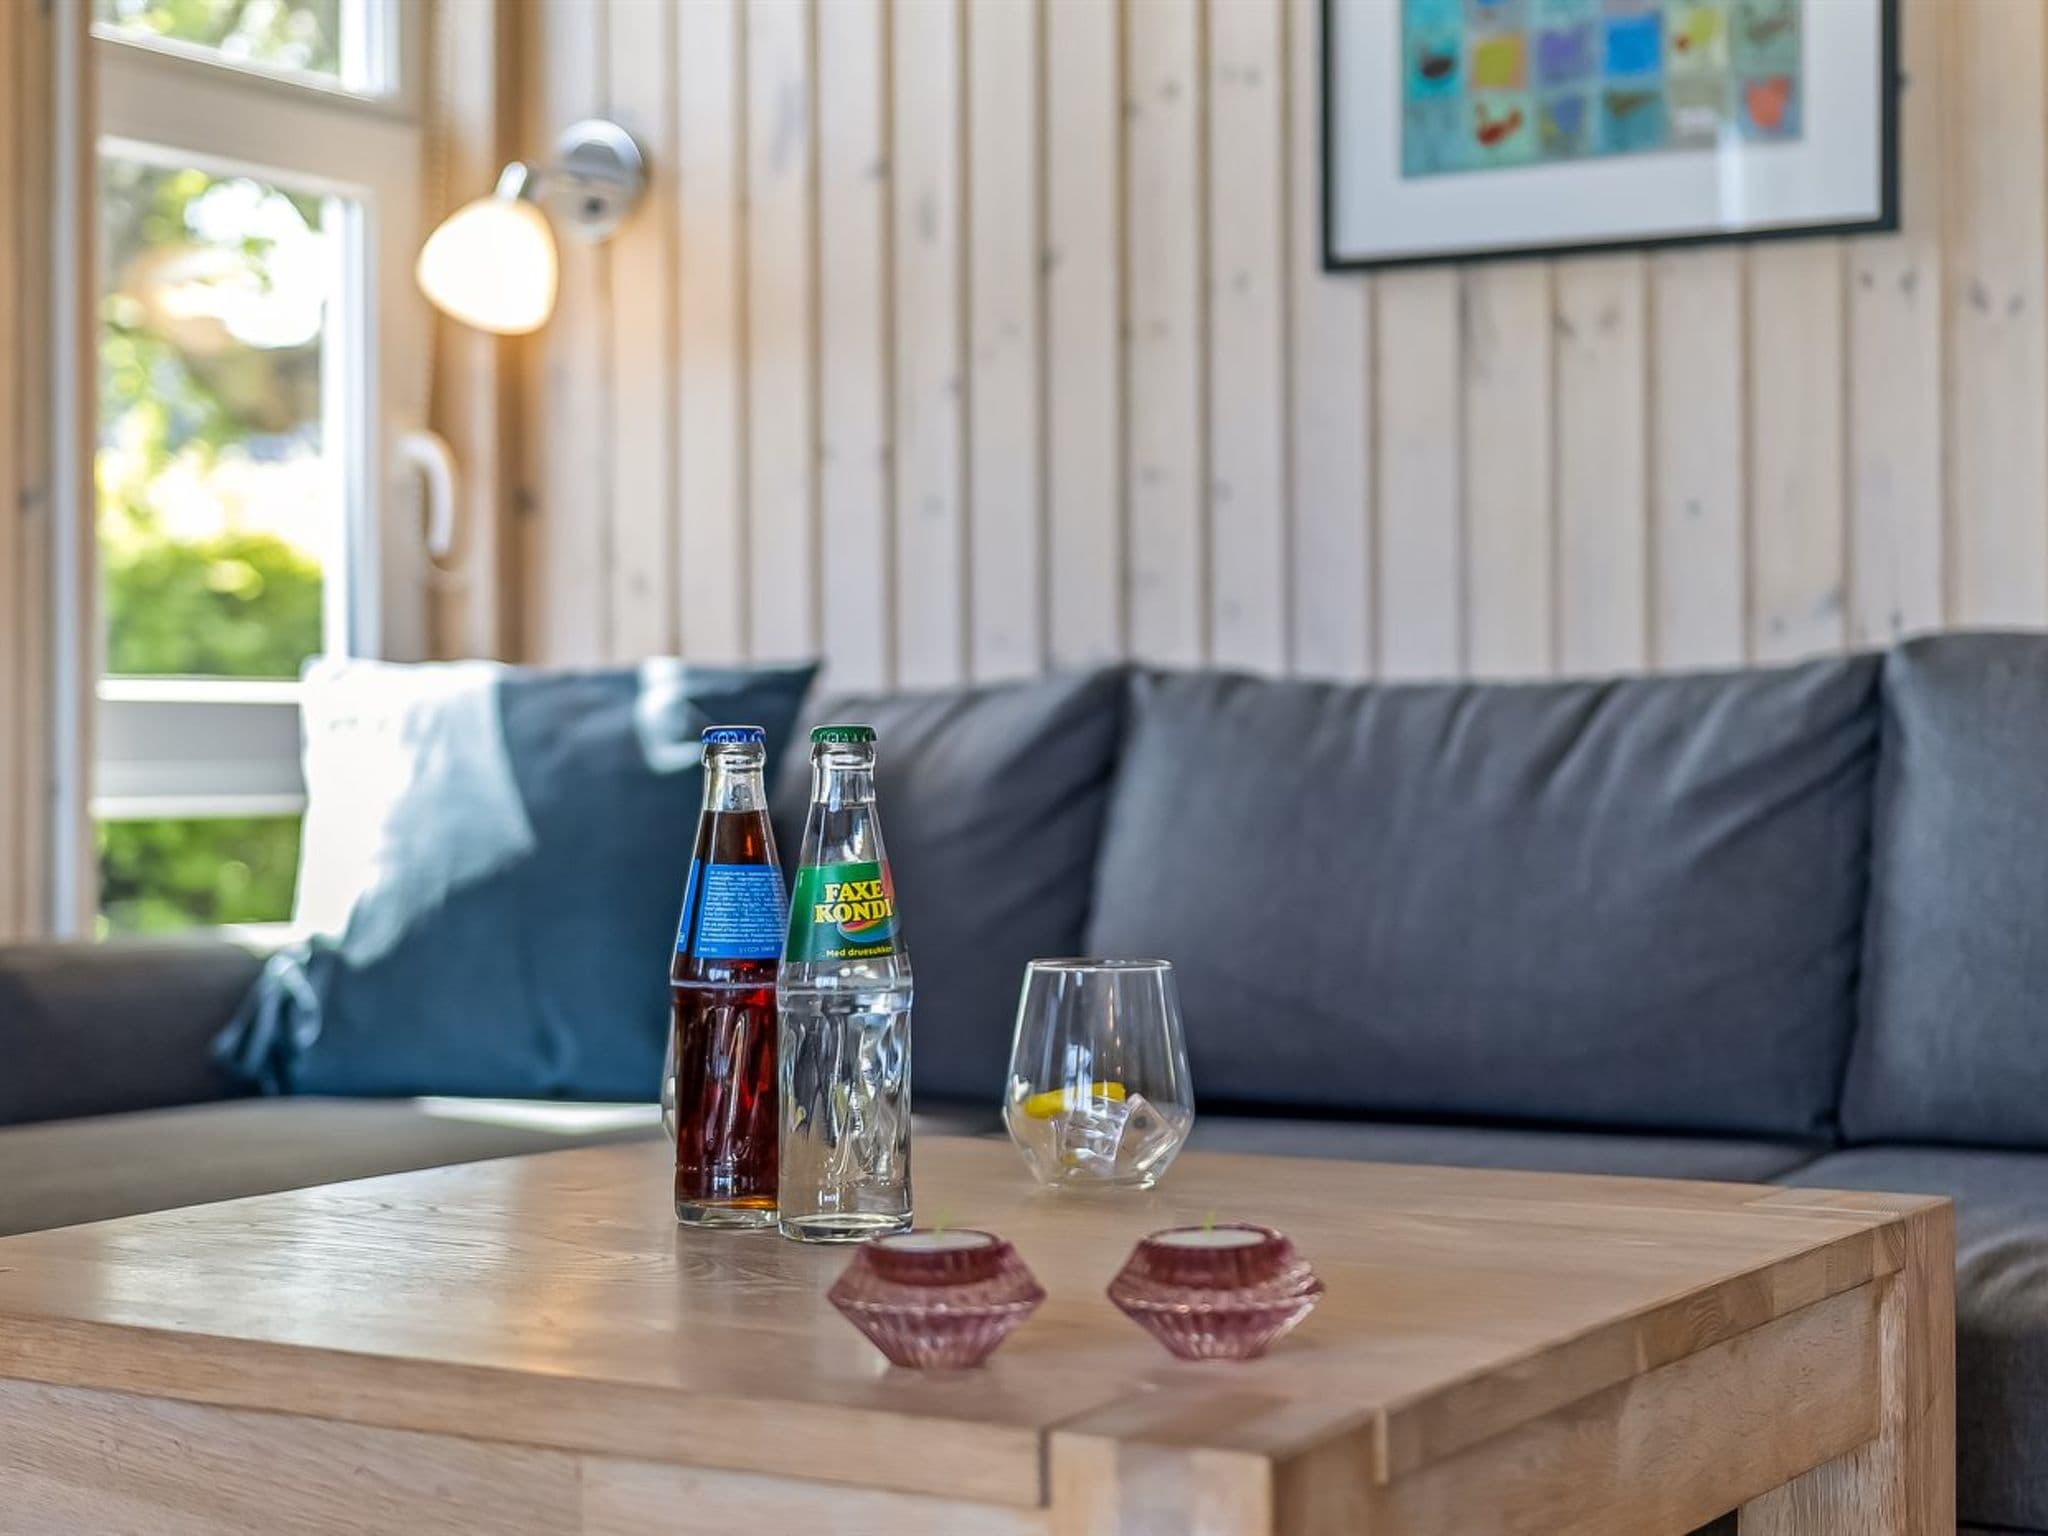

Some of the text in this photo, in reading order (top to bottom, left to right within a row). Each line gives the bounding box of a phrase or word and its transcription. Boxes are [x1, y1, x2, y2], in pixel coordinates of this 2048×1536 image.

[825, 880, 884, 903] FAXE
[814, 899, 894, 924] KONDI
[826, 947, 845, 958] Med
